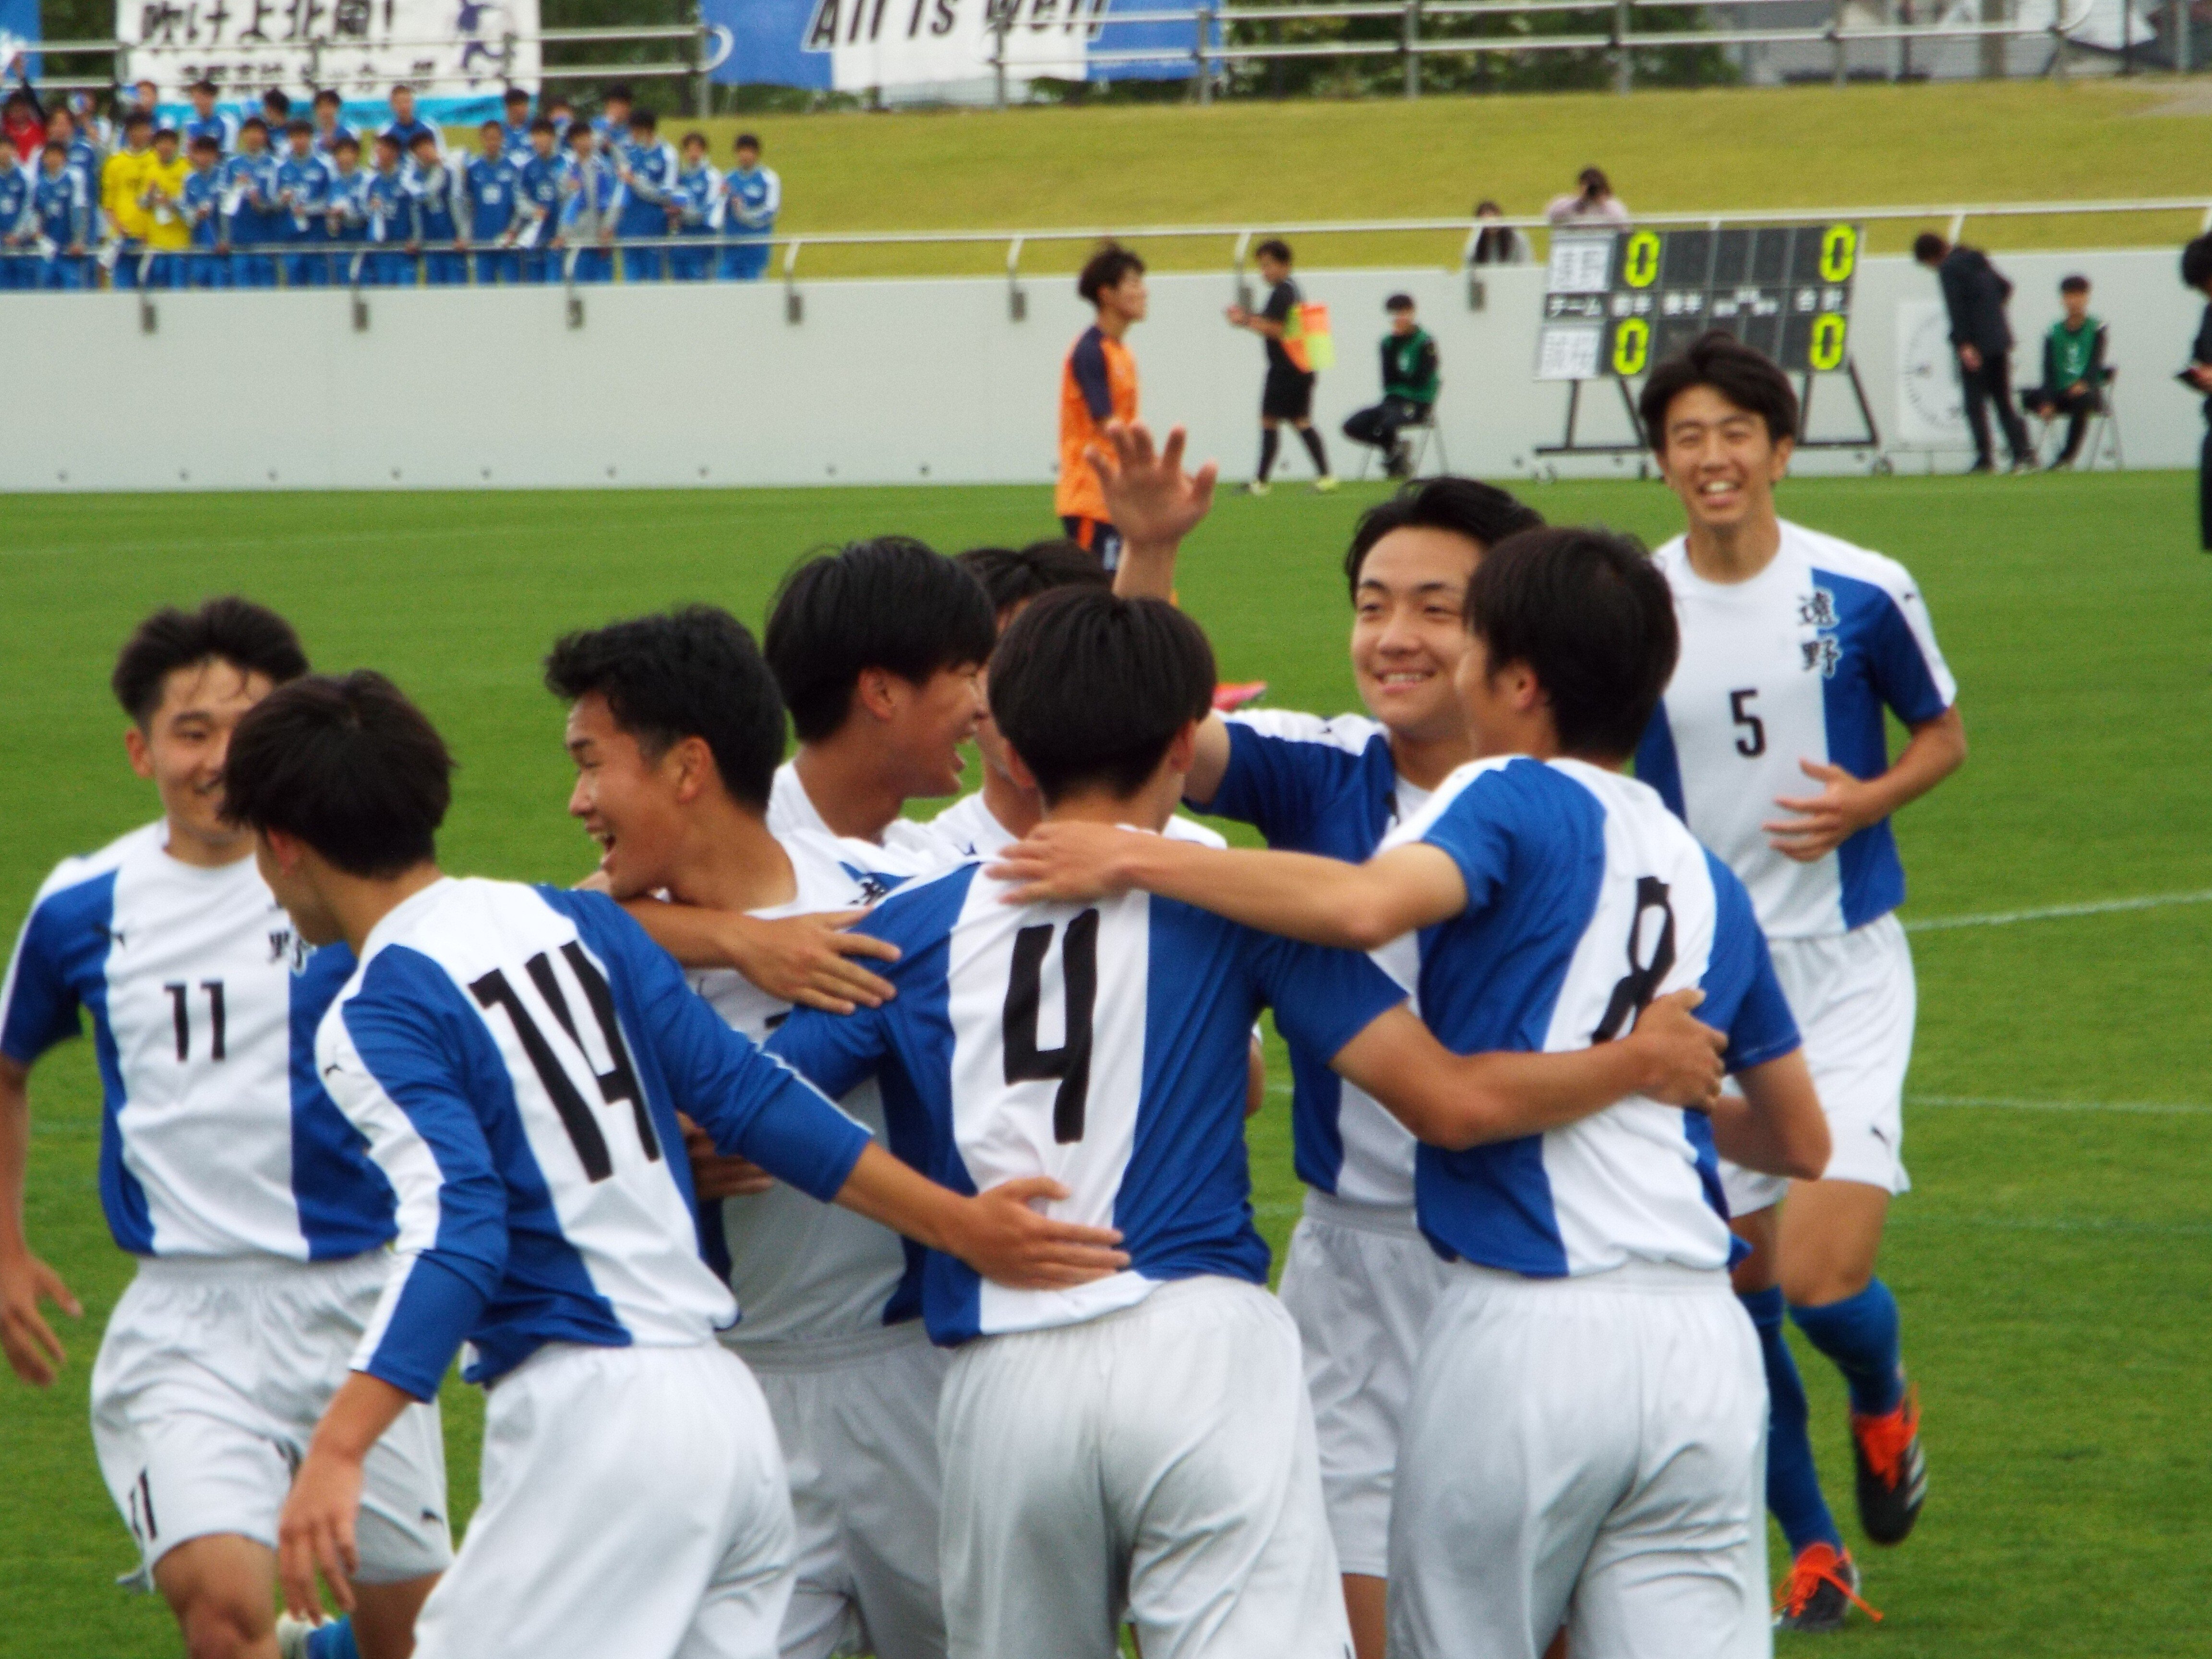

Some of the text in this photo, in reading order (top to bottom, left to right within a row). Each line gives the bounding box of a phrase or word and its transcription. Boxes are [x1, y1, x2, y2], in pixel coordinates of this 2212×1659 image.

[1624, 230, 1661, 288] 0
[1820, 223, 1857, 283] 0
[1613, 318, 1649, 375] 0
[1809, 313, 1846, 370] 0
[1799, 589, 1840, 676] 遠野
[1730, 688, 1766, 757] 5
[1591, 876, 1677, 1045] 8
[164, 979, 226, 1062] 11
[468, 939, 661, 1183] 14
[1002, 907, 1099, 1144] 4
